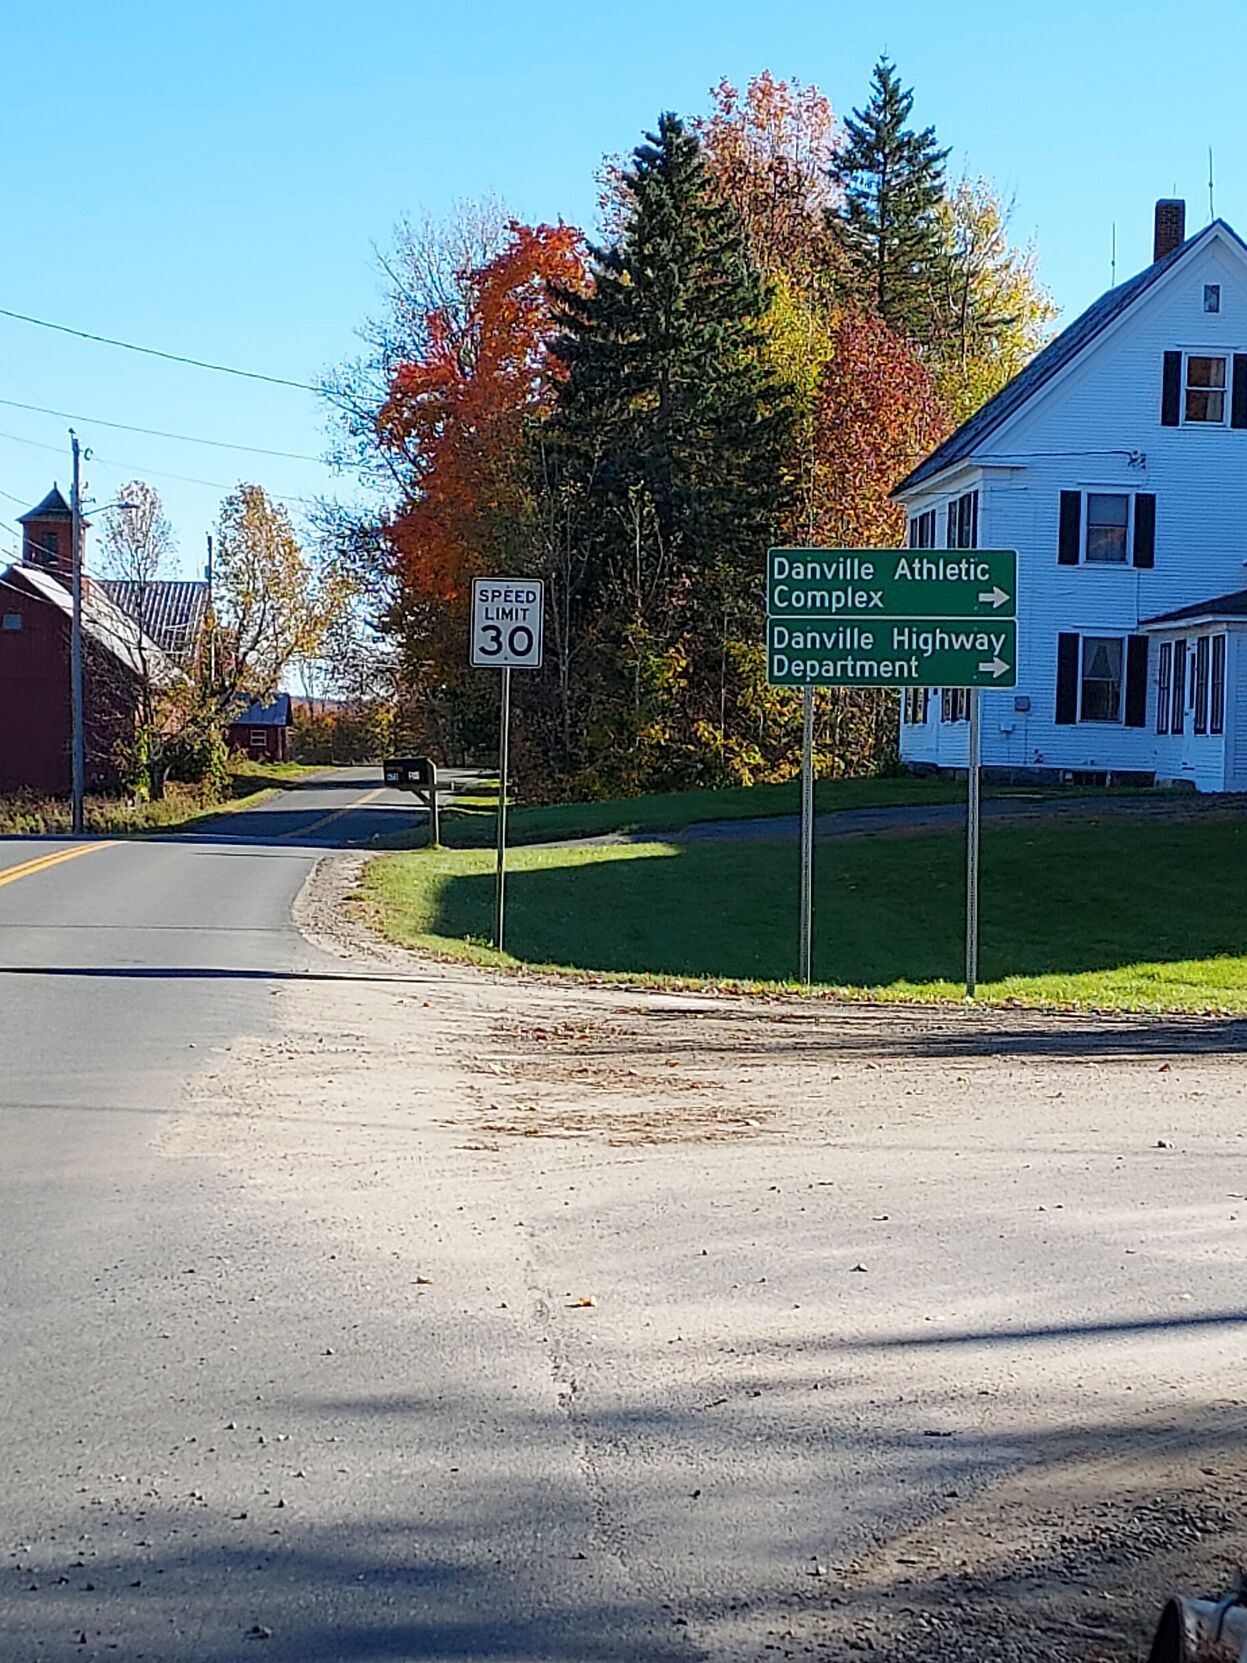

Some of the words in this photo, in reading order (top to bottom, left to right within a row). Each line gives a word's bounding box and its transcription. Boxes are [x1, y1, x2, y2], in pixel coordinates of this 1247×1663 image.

[773, 557, 875, 581] Danville
[893, 557, 990, 581] Athletic
[478, 589, 537, 604] SPEED
[773, 585, 884, 612] Complex
[485, 607, 530, 621] LIMIT
[478, 624, 534, 657] 30
[773, 626, 874, 650] Danville
[892, 627, 1006, 657] Highway
[772, 654, 919, 681] Department
